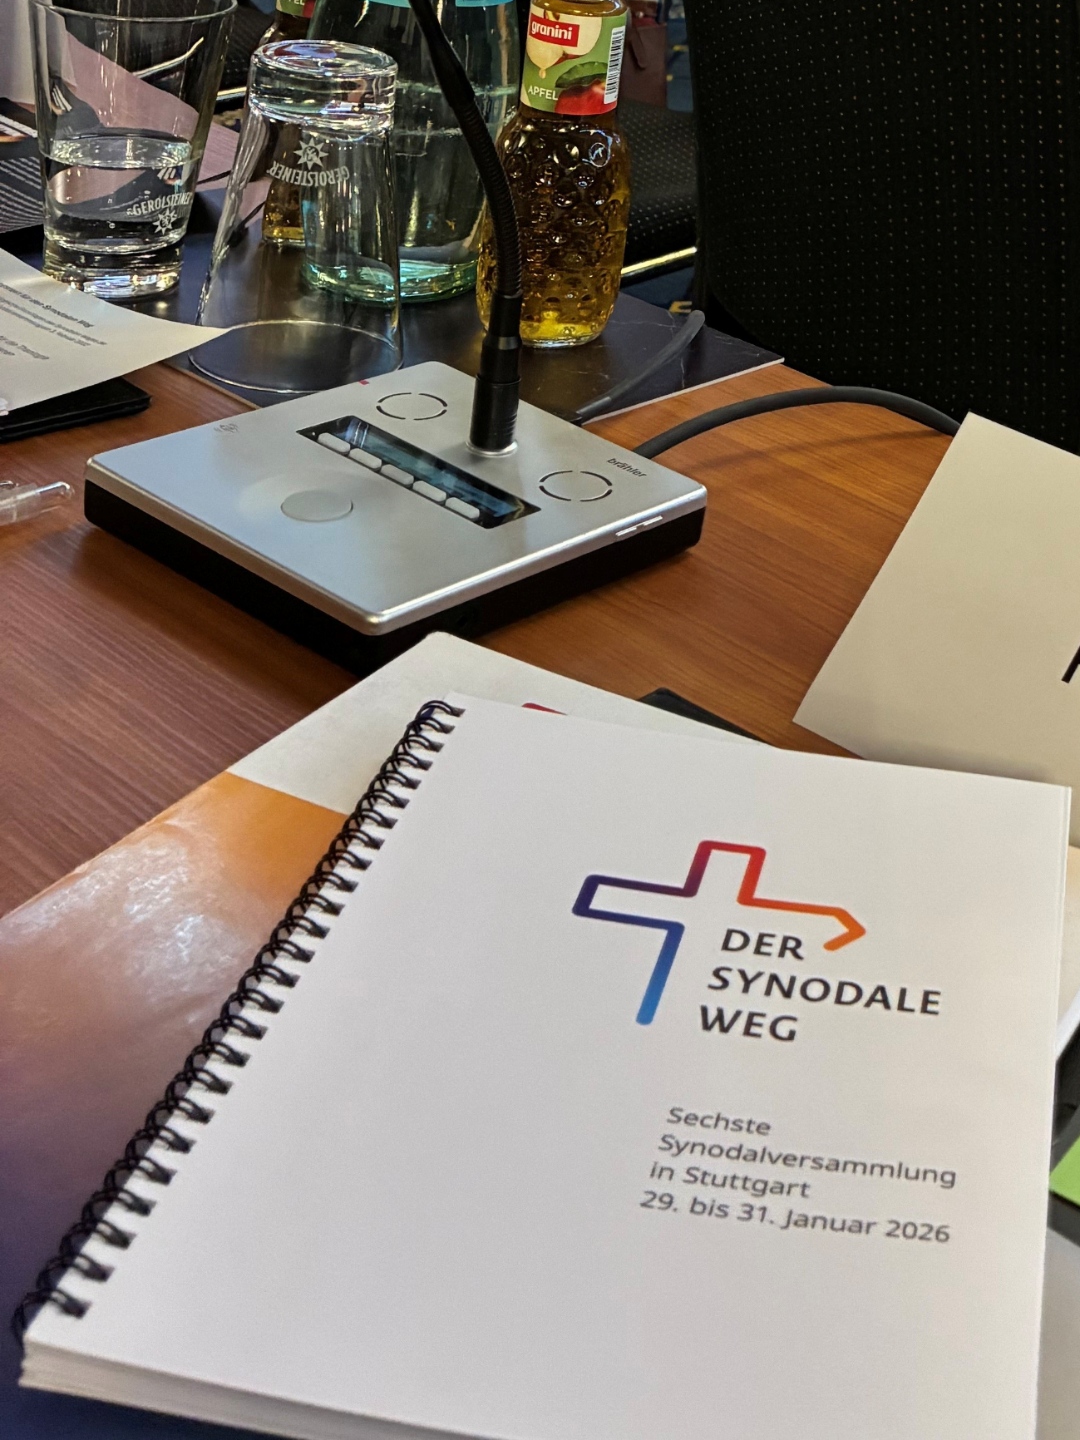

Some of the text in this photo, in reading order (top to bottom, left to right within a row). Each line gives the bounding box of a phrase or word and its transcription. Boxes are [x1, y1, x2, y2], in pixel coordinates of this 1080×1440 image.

[531, 20, 573, 40] granini
[528, 85, 558, 101] APFEL
[607, 458, 647, 477] brähler
[720, 928, 804, 960] DER
[706, 966, 942, 1016] SYNODALE
[699, 1005, 799, 1042] WEG
[666, 1106, 772, 1136] Sechste
[657, 1133, 957, 1189] Synodalversammlung
[649, 1161, 811, 1200] in Stuttgart
[640, 1191, 951, 1243] 29. bis 31. Januar 2026
